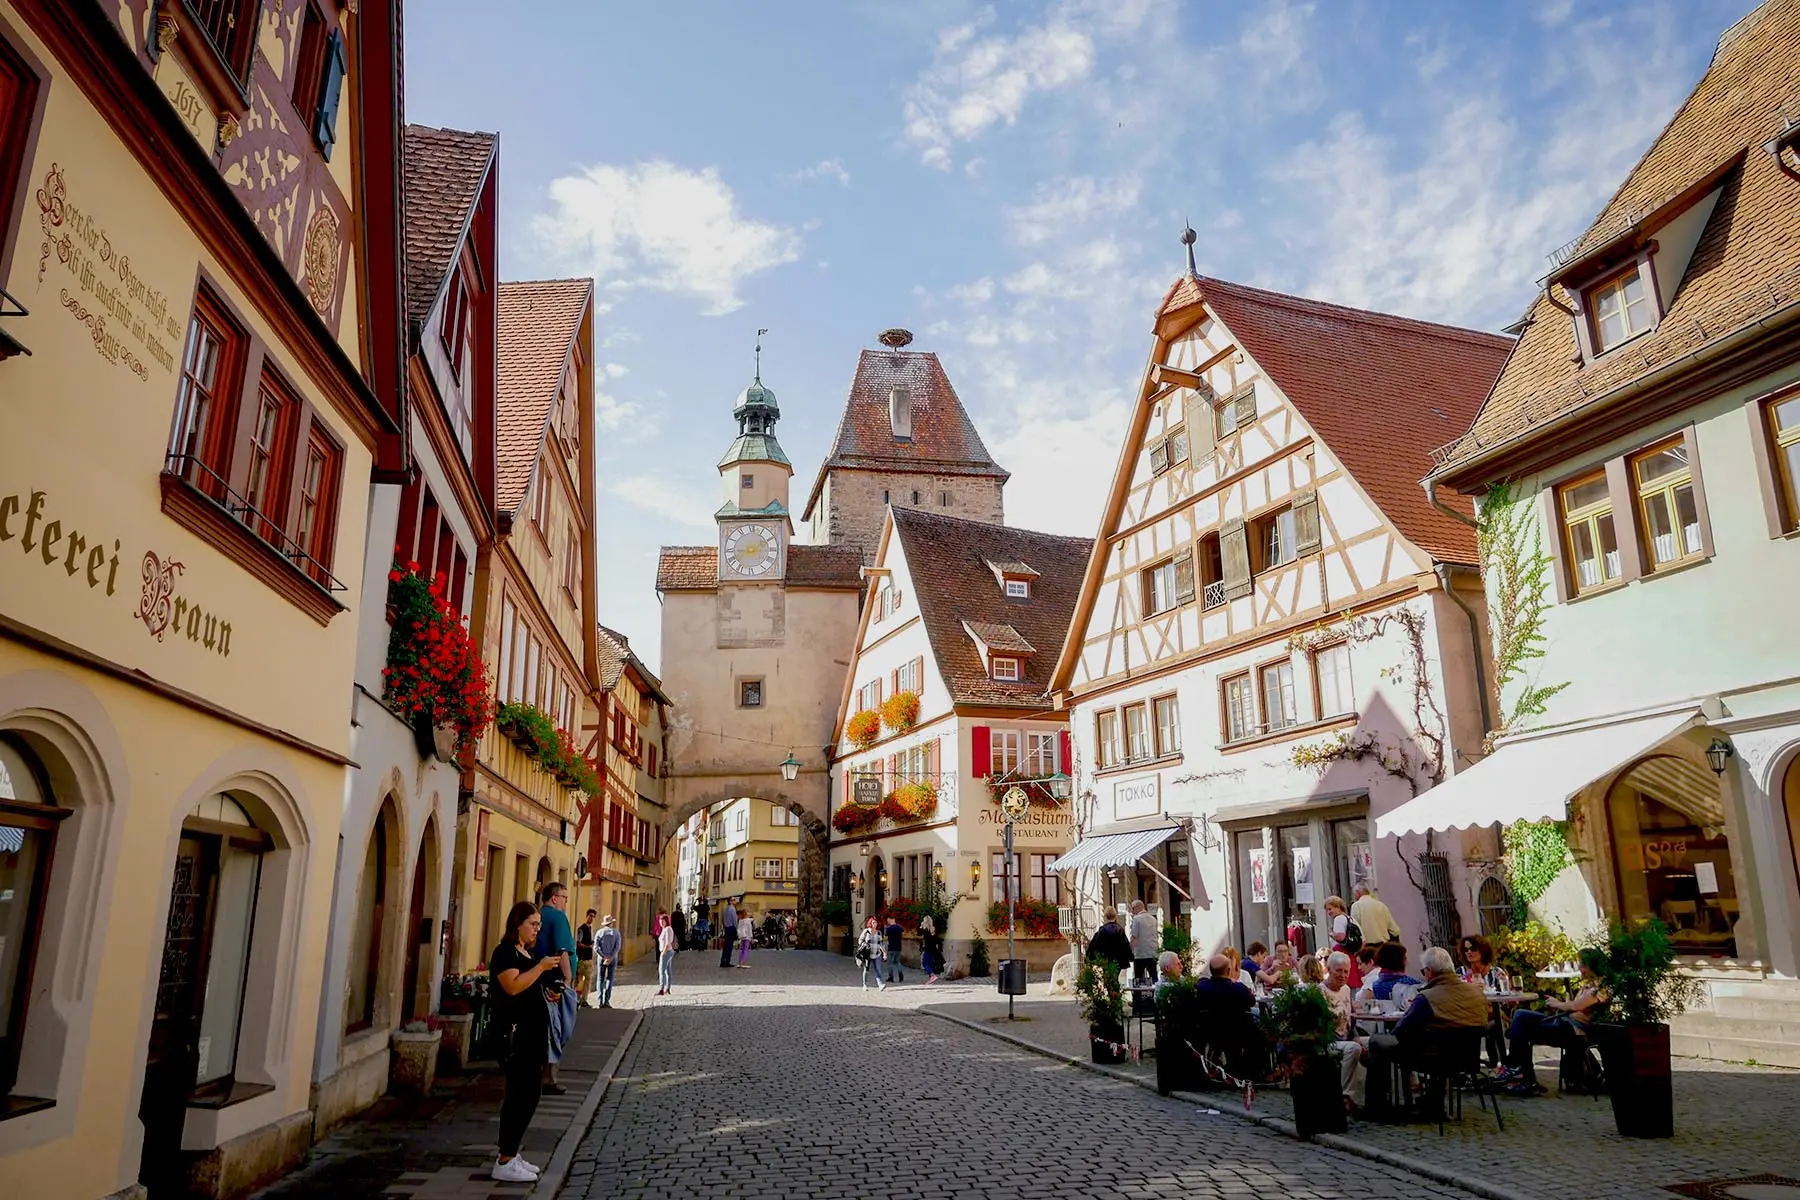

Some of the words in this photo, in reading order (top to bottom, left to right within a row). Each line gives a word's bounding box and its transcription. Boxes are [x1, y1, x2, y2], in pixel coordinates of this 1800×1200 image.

[169, 81, 203, 127] 1617
[80, 257, 96, 293] ihn
[95, 280, 121, 318] auch
[115, 299, 133, 329] mir
[146, 332, 174, 375] meinem
[99, 230, 117, 272] Du
[166, 316, 181, 341] aus
[133, 550, 232, 658] Braun
[1119, 782, 1155, 802] TOKKO
[996, 829, 1059, 838] RSTAURANT
